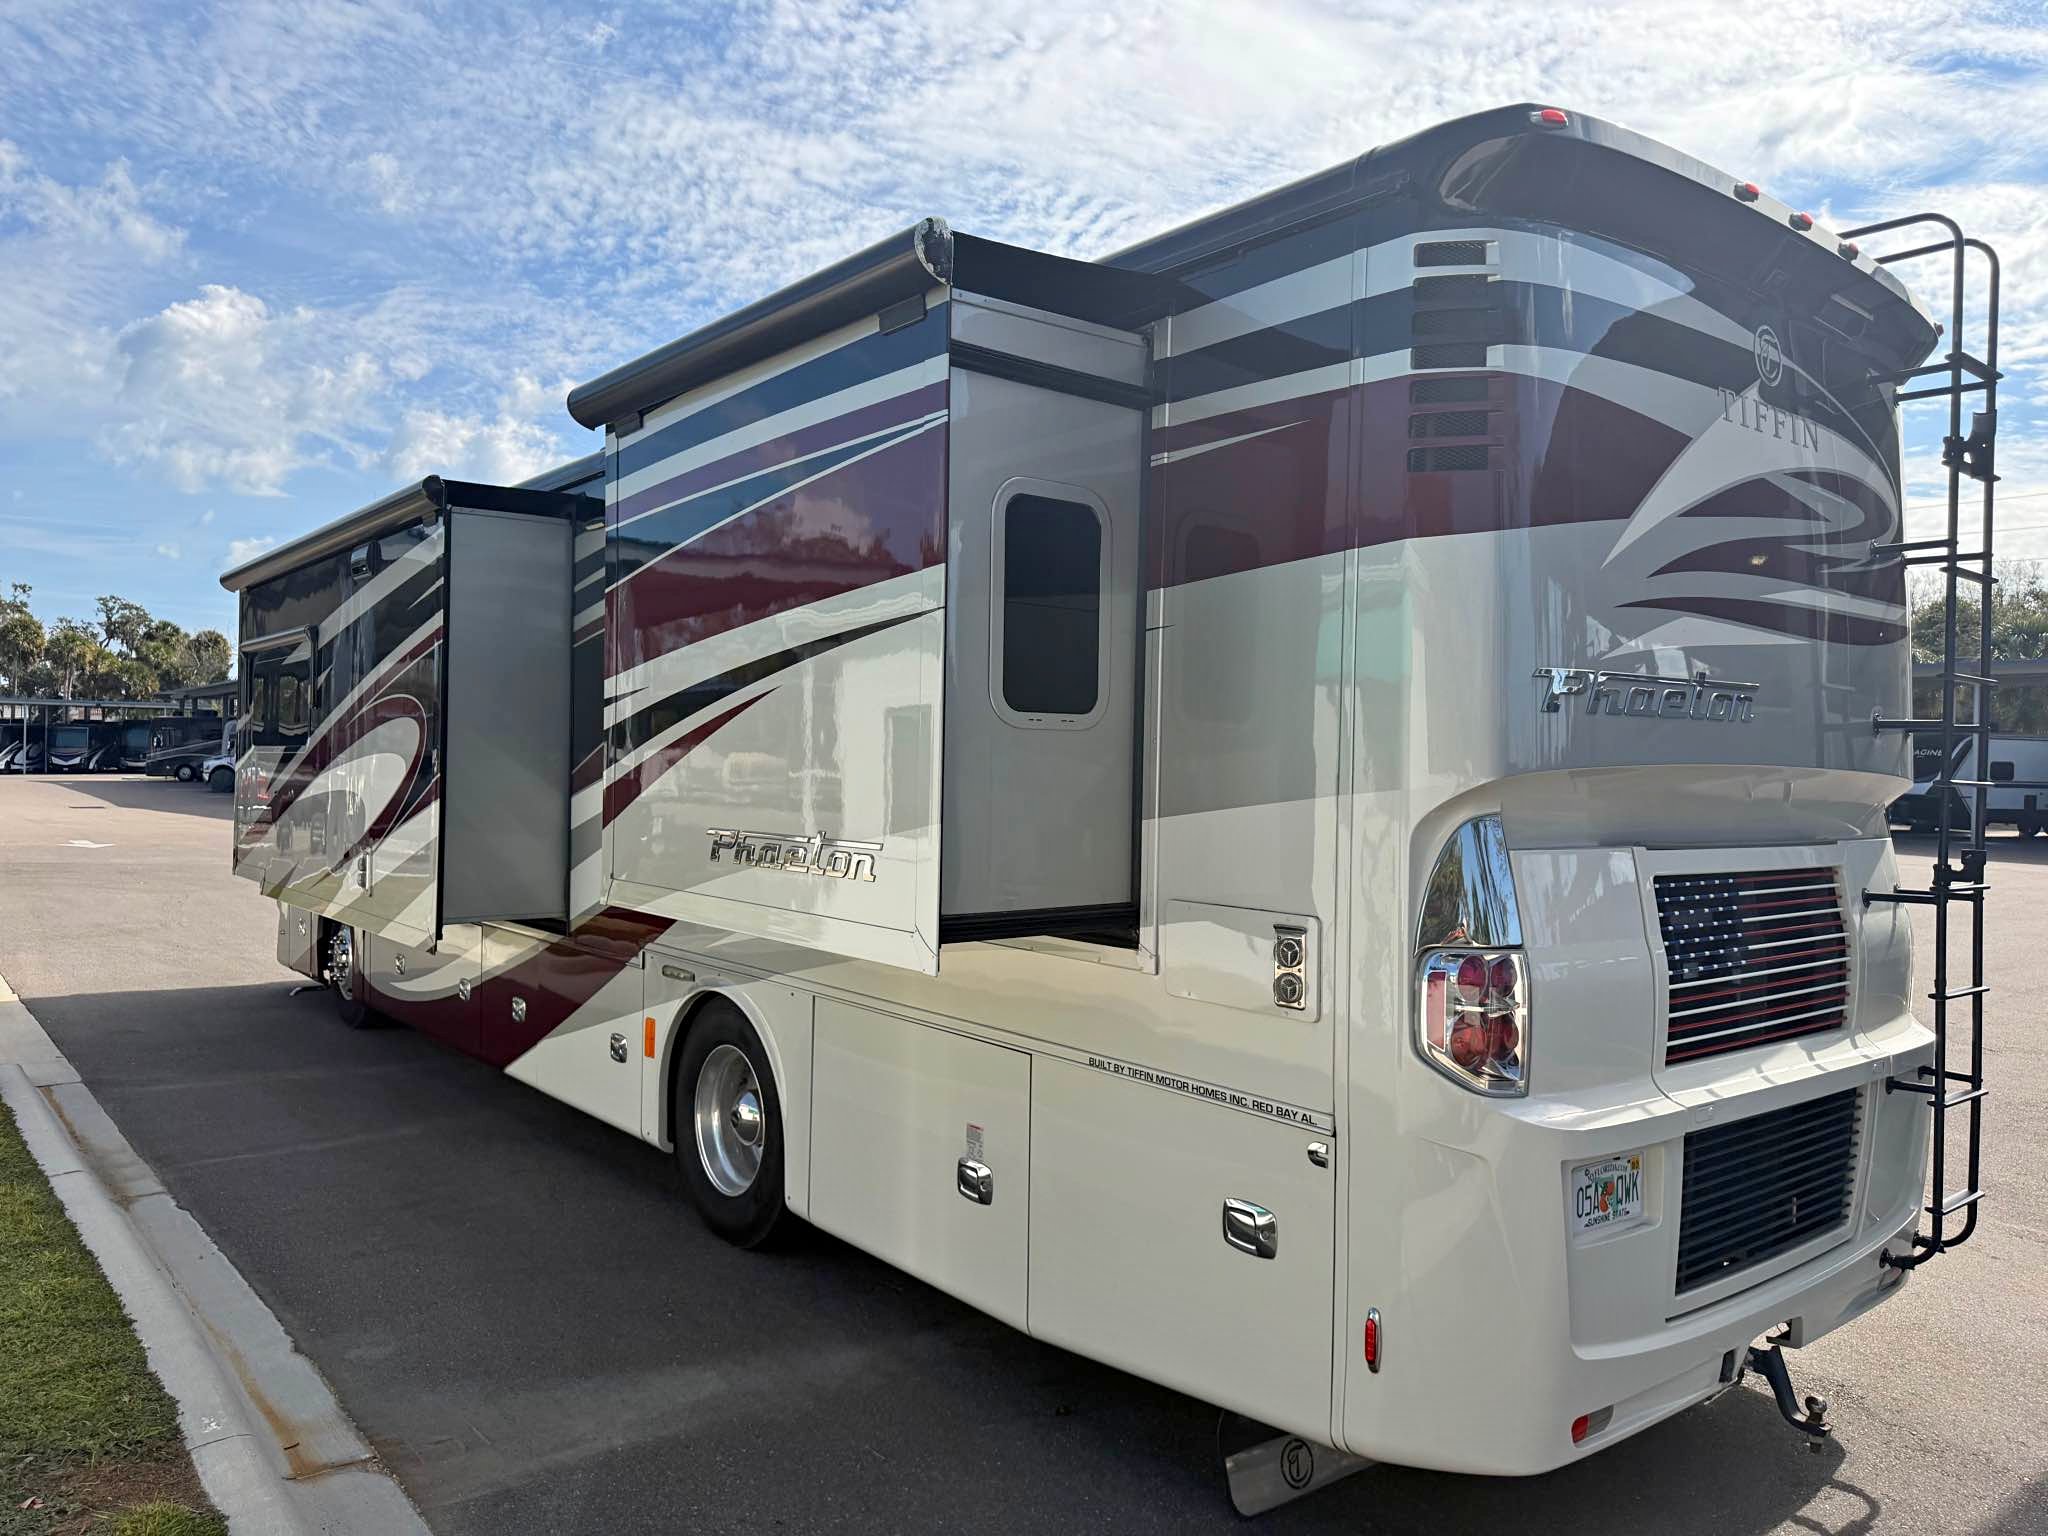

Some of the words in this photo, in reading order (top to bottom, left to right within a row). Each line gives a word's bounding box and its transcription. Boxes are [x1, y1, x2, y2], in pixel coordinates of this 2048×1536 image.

[1716, 386, 1819, 453] TIFFIN
[1532, 667, 1760, 722] Phaeton
[706, 827, 884, 883] Phaeton
[1088, 1056, 1112, 1070] BUILT
[1113, 1063, 1125, 1074] BY
[1127, 1066, 1154, 1082] TIFFIN
[1155, 1074, 1190, 1091] MOTOR
[1191, 1084, 1227, 1101] HOMES
[1252, 1100, 1273, 1113] RED
[1276, 1106, 1299, 1120] BAY
[1576, 1182, 1600, 1219] 05A
